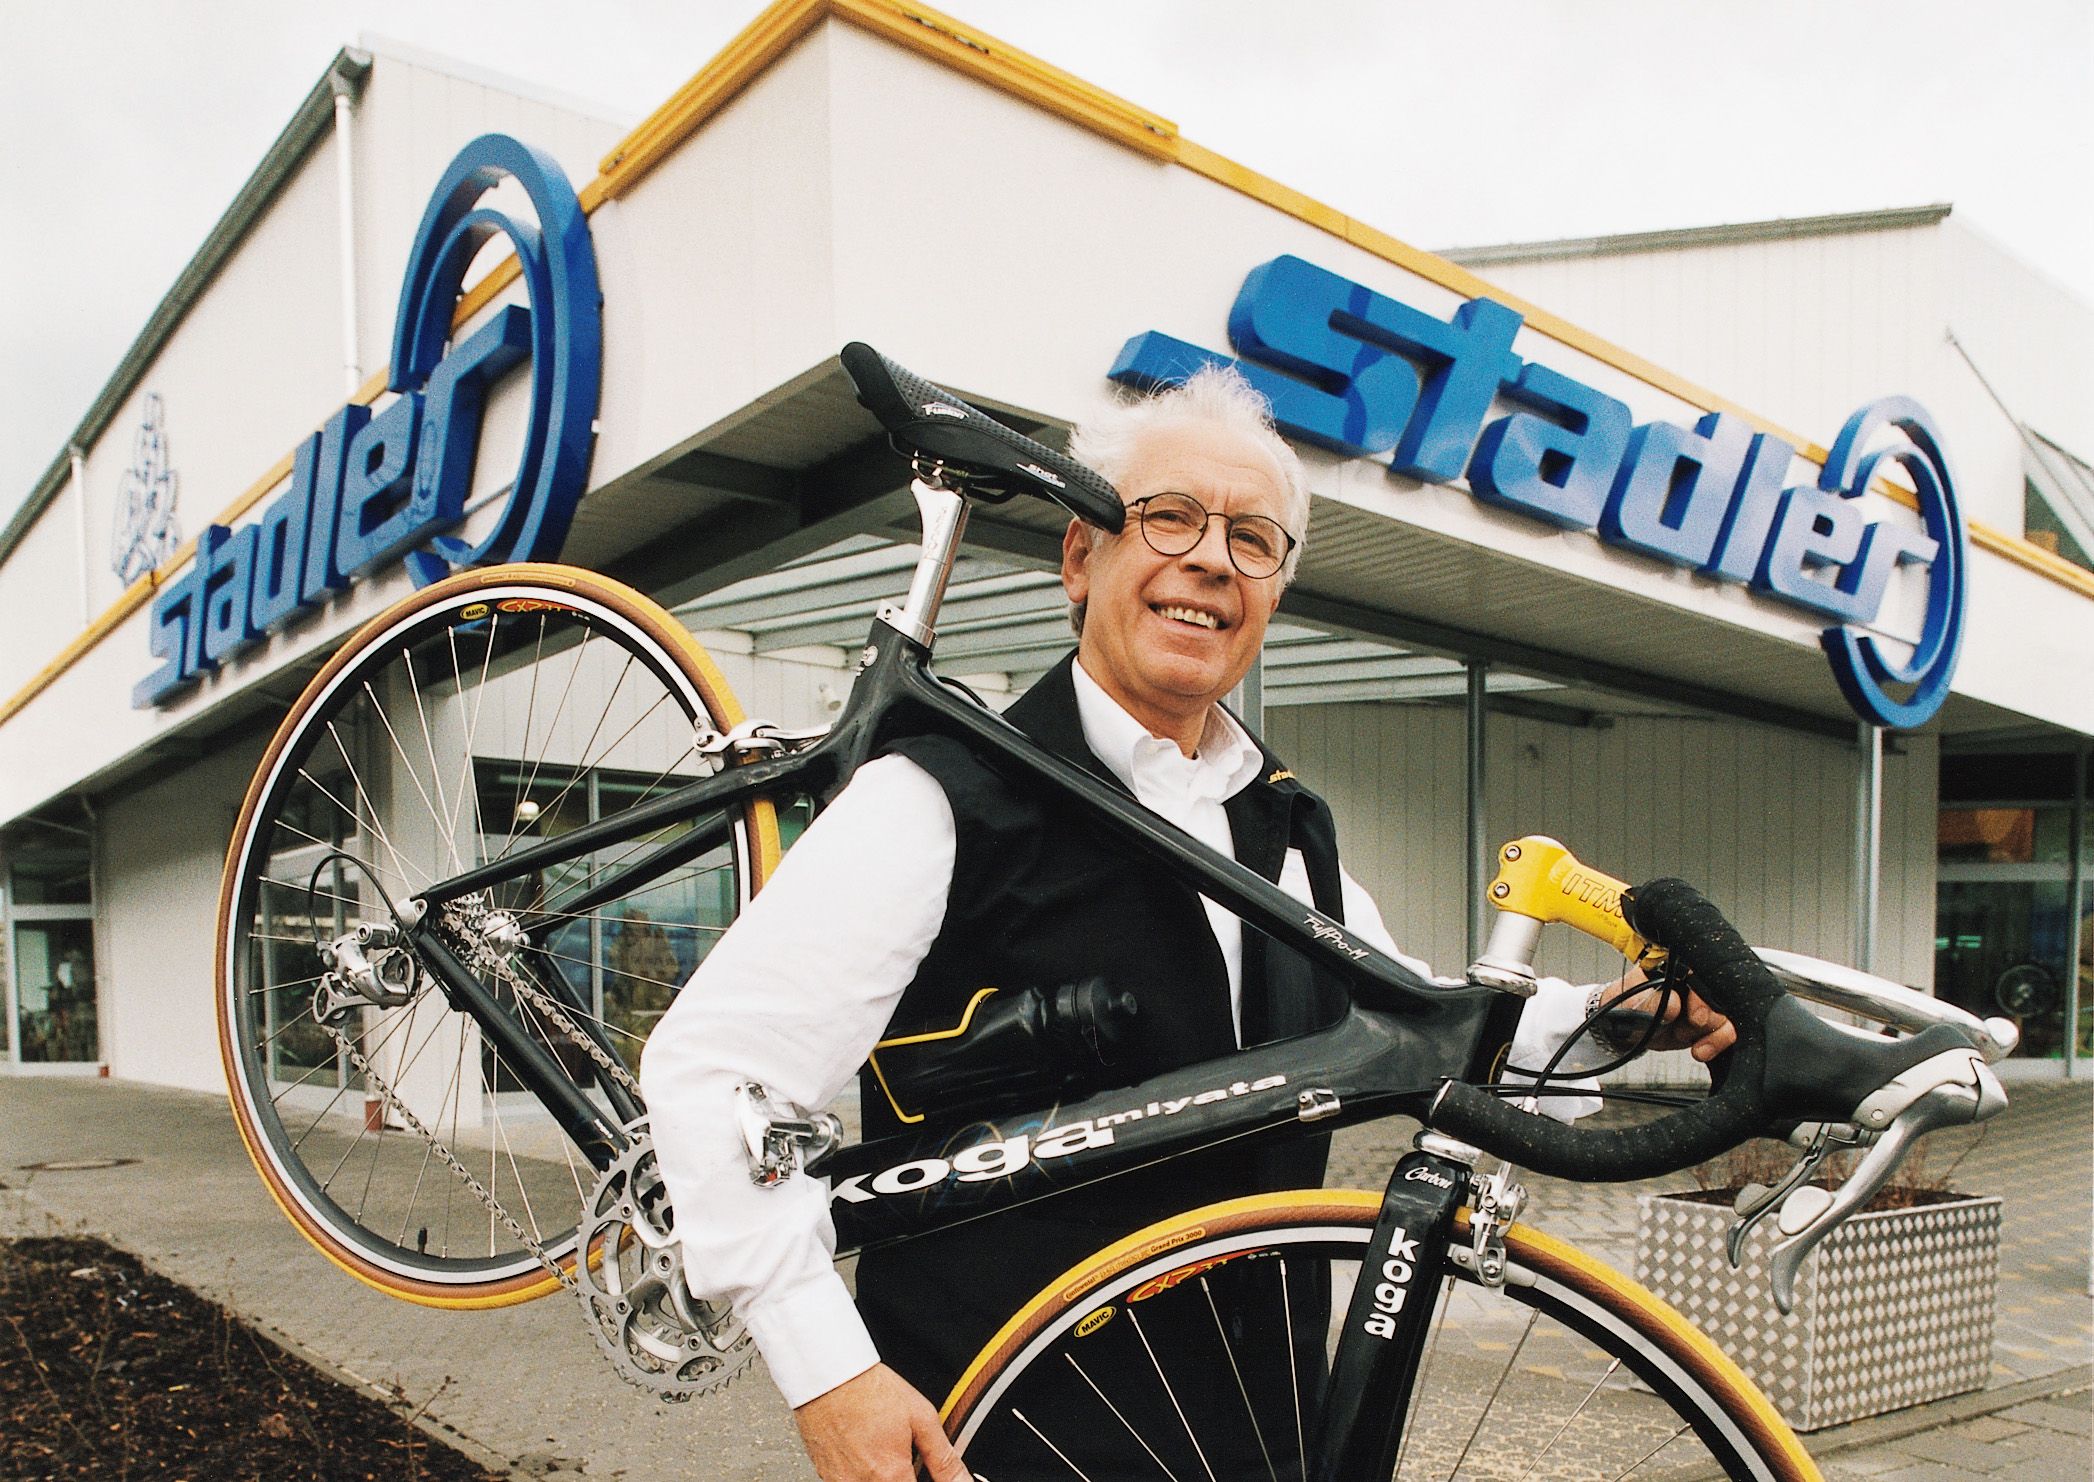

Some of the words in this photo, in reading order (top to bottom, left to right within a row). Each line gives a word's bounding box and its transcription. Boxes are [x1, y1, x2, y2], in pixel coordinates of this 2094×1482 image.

[1105, 253, 1939, 624] stadler
[131, 304, 532, 709] stadler
[464, 607, 486, 619] MAVIC
[1562, 872, 1624, 919] ITM
[828, 1119, 1116, 1209] koga
[1097, 1073, 1288, 1129] miyata
[1404, 1166, 1453, 1190] Carbon
[1150, 1240, 1171, 1253] Grand
[1185, 1229, 1203, 1241] 3000
[1363, 1226, 1421, 1340] koga
[1080, 1310, 1110, 1334] MAVIC
